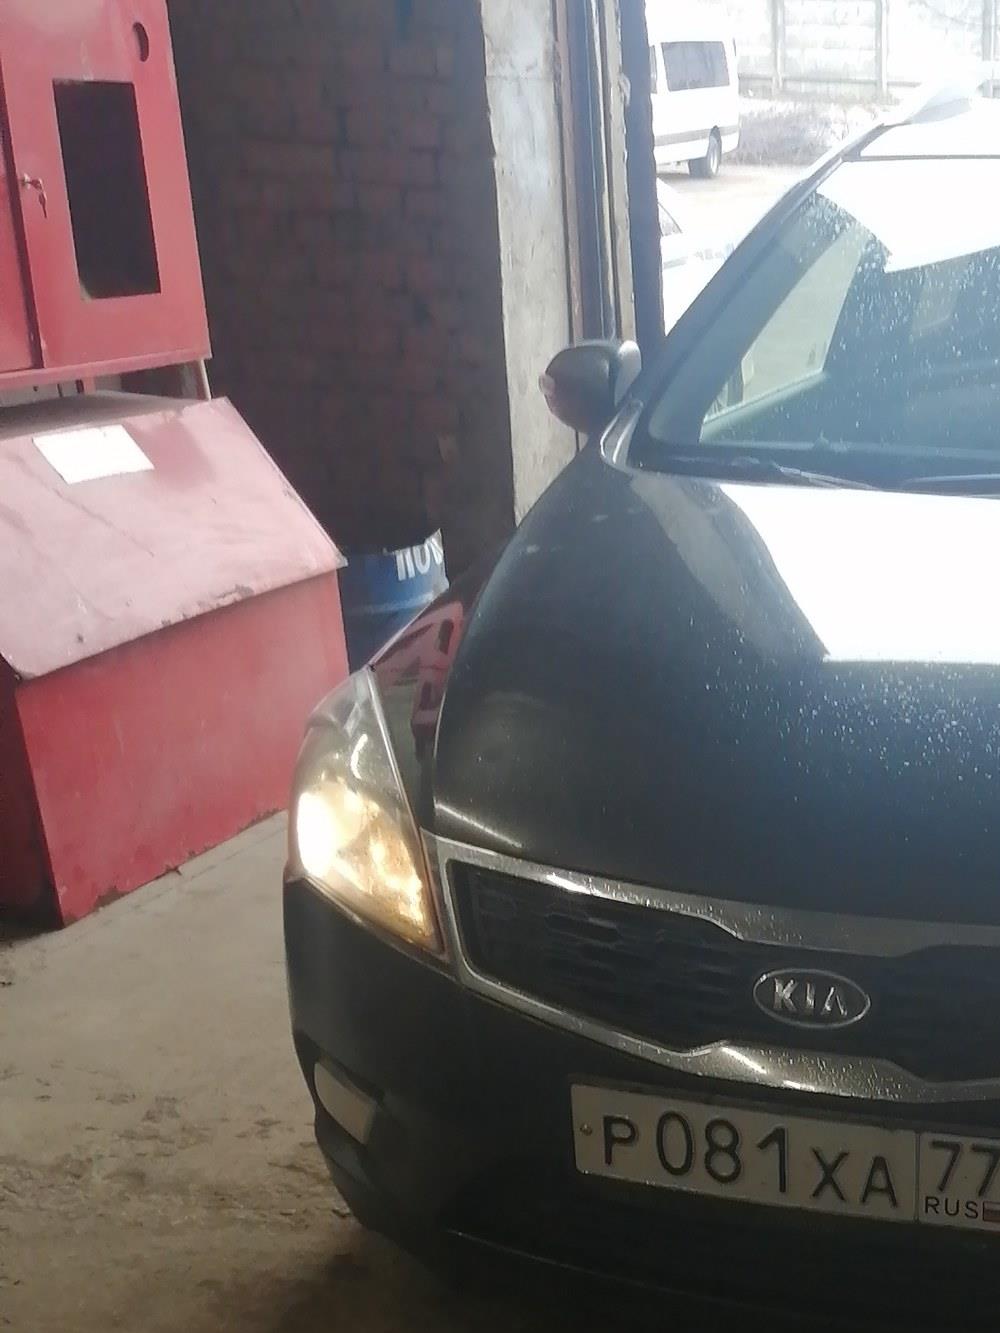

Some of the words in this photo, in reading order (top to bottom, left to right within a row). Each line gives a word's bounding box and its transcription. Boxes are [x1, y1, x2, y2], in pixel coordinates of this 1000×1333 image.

[773, 978, 848, 1016] KIA
[602, 1110, 898, 1208] P081XA
[924, 1195, 979, 1219] RUS
